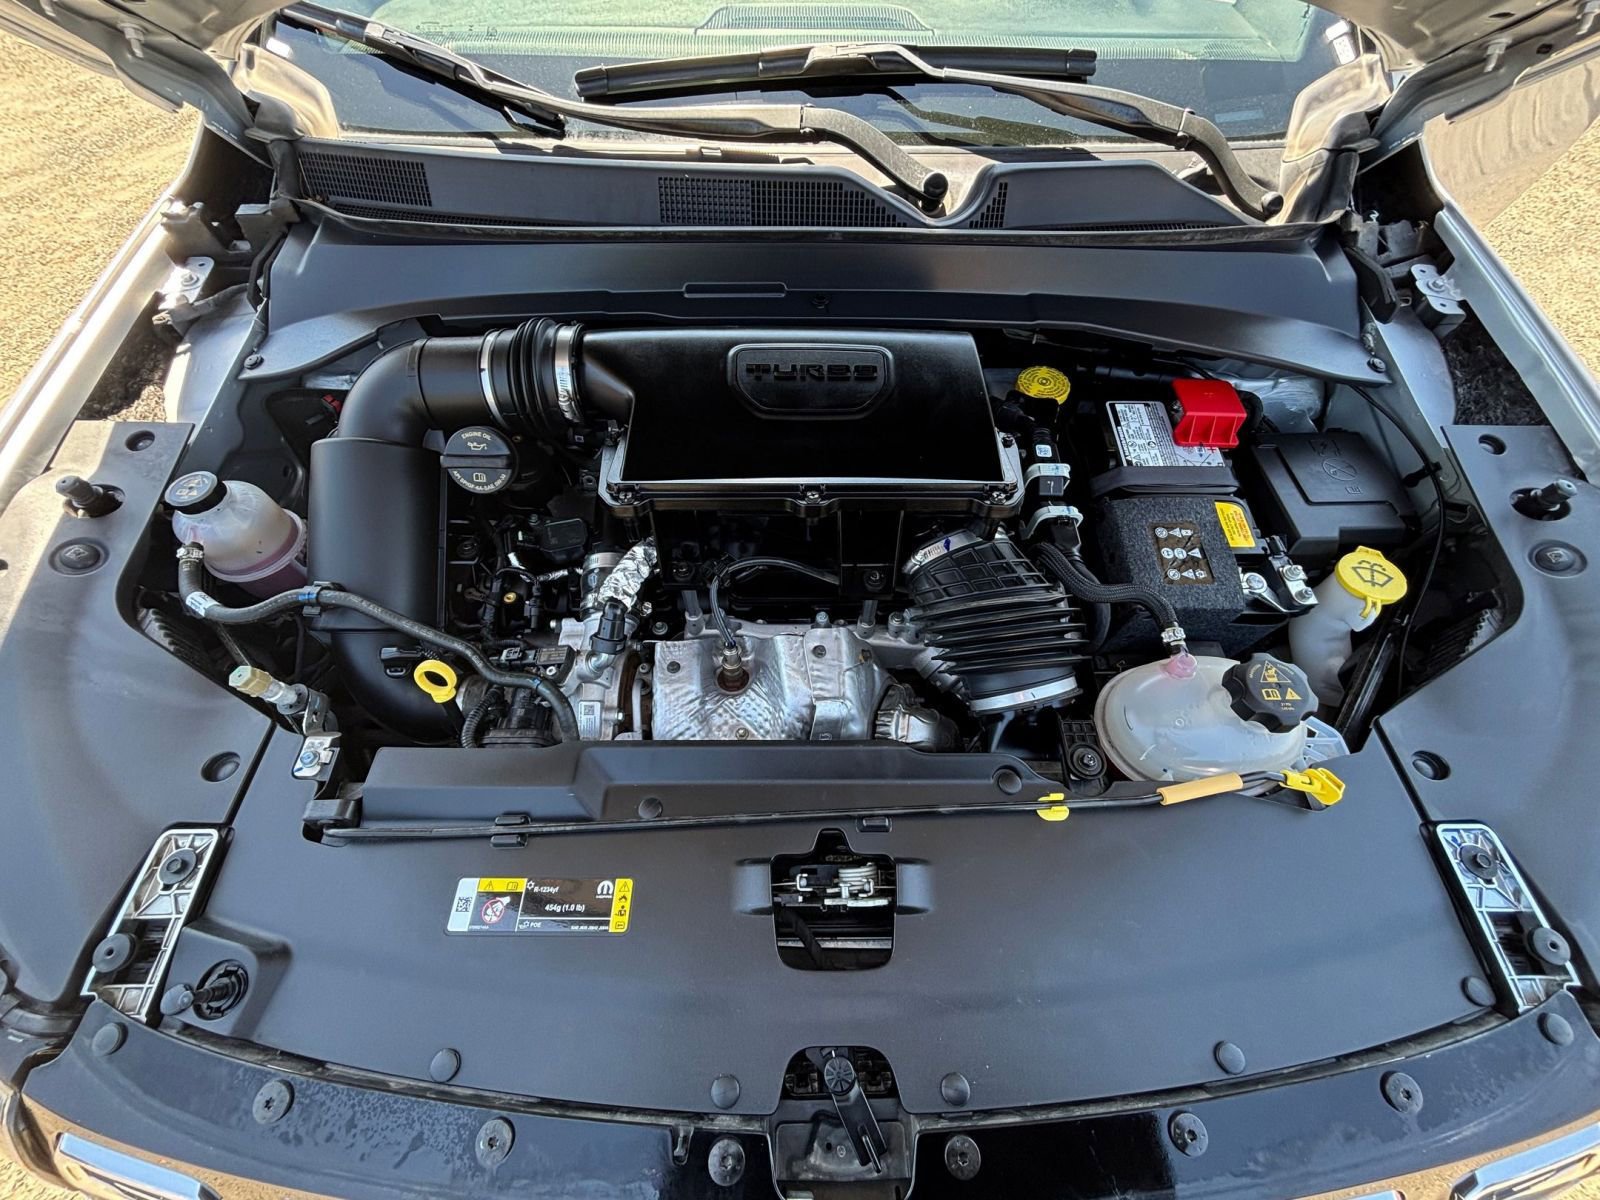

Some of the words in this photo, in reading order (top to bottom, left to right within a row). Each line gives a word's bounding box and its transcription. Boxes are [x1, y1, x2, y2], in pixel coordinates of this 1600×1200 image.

[746, 363, 878, 382] TURBO
[461, 431, 482, 440] ENGINE
[482, 433, 492, 441] OIL
[533, 886, 560, 894] R-1234yf
[544, 903, 562, 913] 454g
[562, 903, 575, 913] (1.0
[575, 903, 586, 913] lb)
